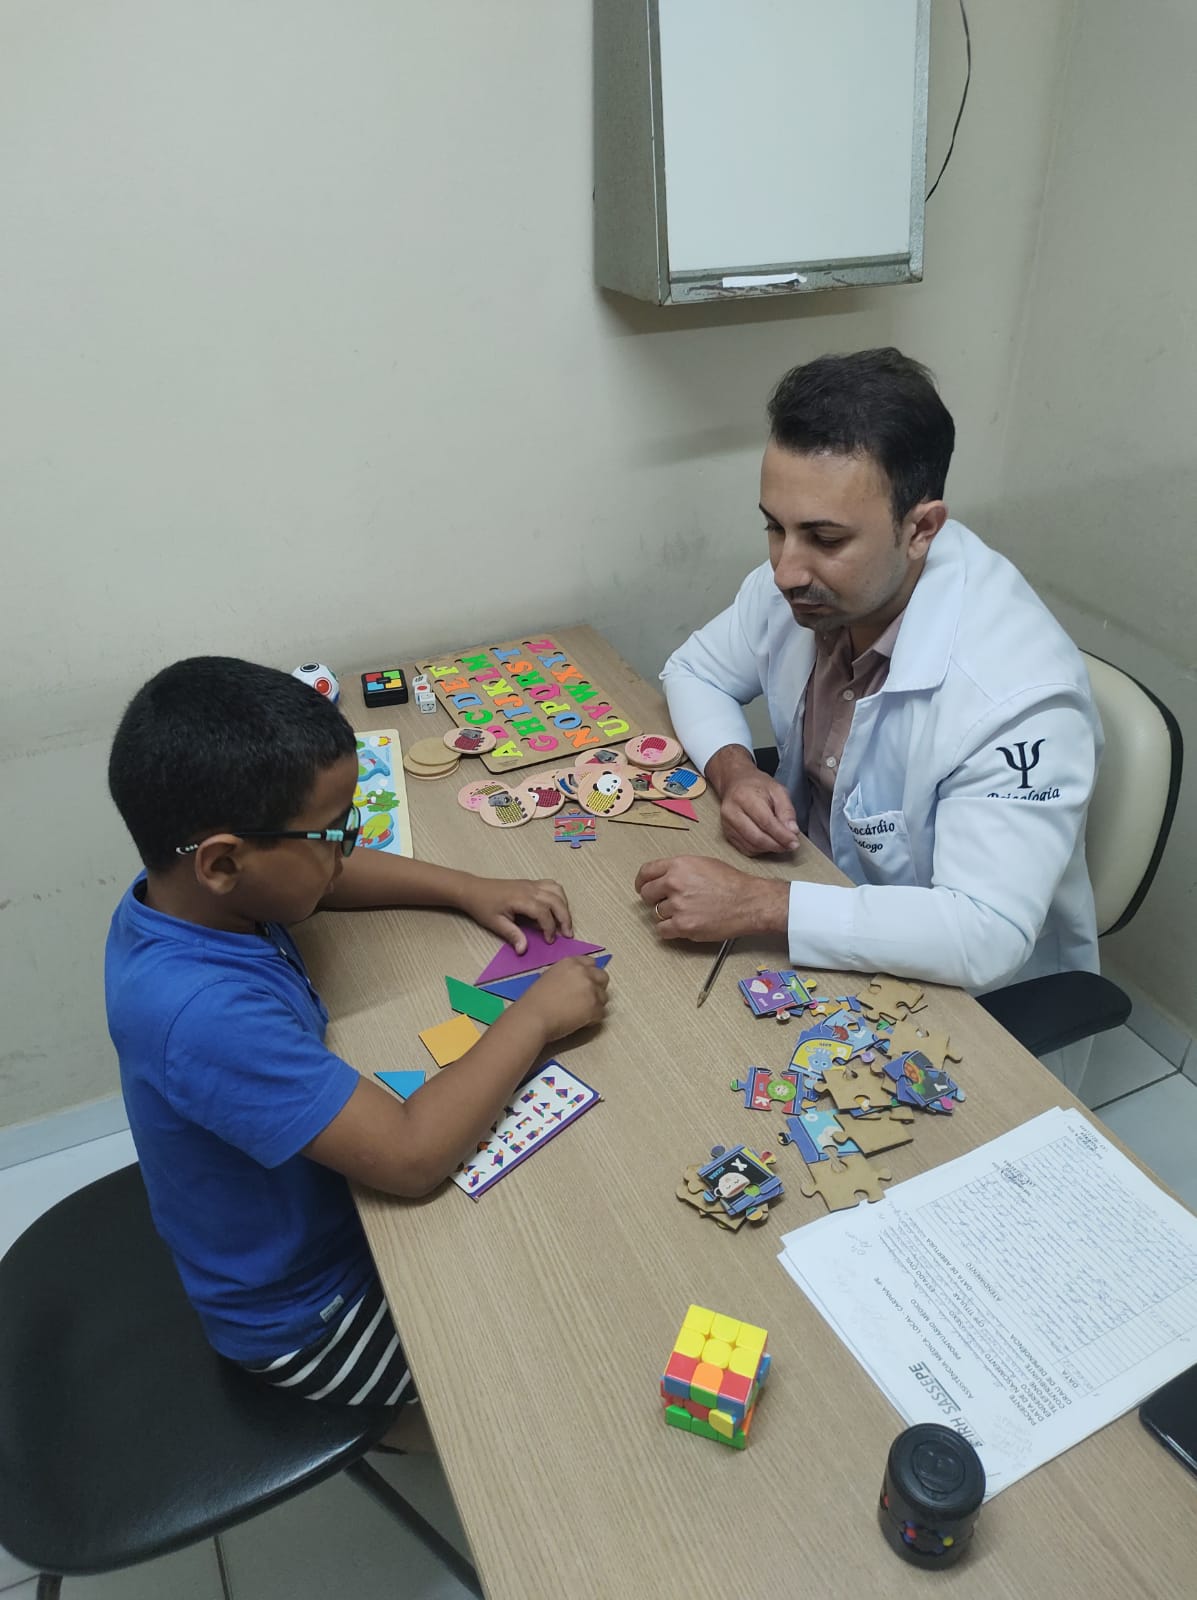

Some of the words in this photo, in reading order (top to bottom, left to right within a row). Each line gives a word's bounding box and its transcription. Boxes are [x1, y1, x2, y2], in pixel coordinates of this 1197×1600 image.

[461, 653, 494, 671] M
[506, 661, 534, 673] S
[537, 654, 567, 668] Y
[429, 666, 459, 677] F
[516, 671, 545, 687] R
[551, 666, 583, 683] X
[439, 677, 470, 693] E
[482, 679, 513, 697] K
[529, 683, 560, 700] Q
[564, 684, 599, 703] W
[453, 693, 483, 709] D
[540, 701, 570, 714] P
[465, 709, 493, 725] C
[553, 713, 582, 729] O
[512, 717, 546, 736] H
[597, 719, 630, 736] U
[492, 741, 523, 757] A
[528, 735, 559, 751] G
[754, 1095, 770, 1106] K
[731, 1158, 747, 1172] X
[925, 1237, 951, 1266] ABERTURA
[949, 1265, 958, 1275] DE
[915, 1269, 936, 1293] ESTADO
[956, 1273, 972, 1291] DATA
[965, 1261, 1002, 1302] ATENDIMENTO
[881, 1286, 903, 1312] CARPINA
[951, 1290, 974, 1316] TITULAR
[909, 1297, 930, 1322] MÉDICO
[904, 1314, 921, 1334] LOCAL
[921, 1336, 943, 1361] MÉDICA
[927, 1321, 961, 1360] PRONTUÁRIO
[940, 1360, 974, 1400] ASSISTÊNCIA
[983, 1351, 1020, 1393] NASCIMENTO
[1045, 1376, 1056, 1386] DE
[1060, 1369, 1079, 1389] DATA
[908, 1360, 958, 1418] SASSEPE
[1024, 1362, 1065, 1410] CONTRIBUINTE
[1018, 1392, 1028, 1403] DE
[1028, 1380, 1057, 1413] TELEFONE
[1053, 1385, 1072, 1406] GRAU
[1008, 1393, 1037, 1426] PACIENTE
[1026, 1401, 1044, 1422] DATA
